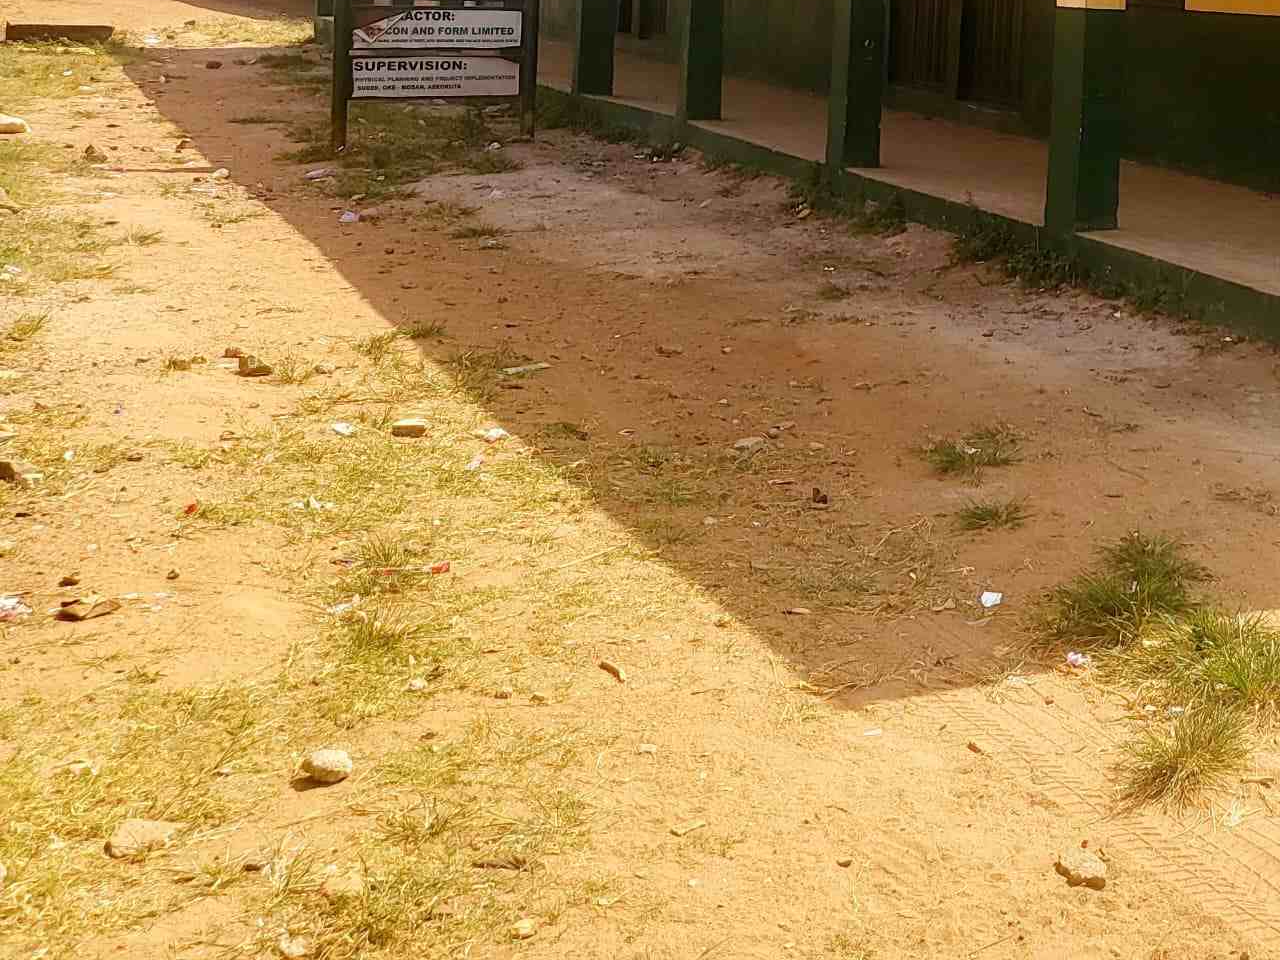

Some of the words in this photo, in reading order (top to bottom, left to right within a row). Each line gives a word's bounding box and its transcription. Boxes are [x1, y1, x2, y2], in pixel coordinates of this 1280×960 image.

[411, 26, 434, 35] AND
[438, 26, 469, 35] FORM
[471, 26, 515, 35] LIMITED
[354, 60, 468, 72] SUPERVISION:
